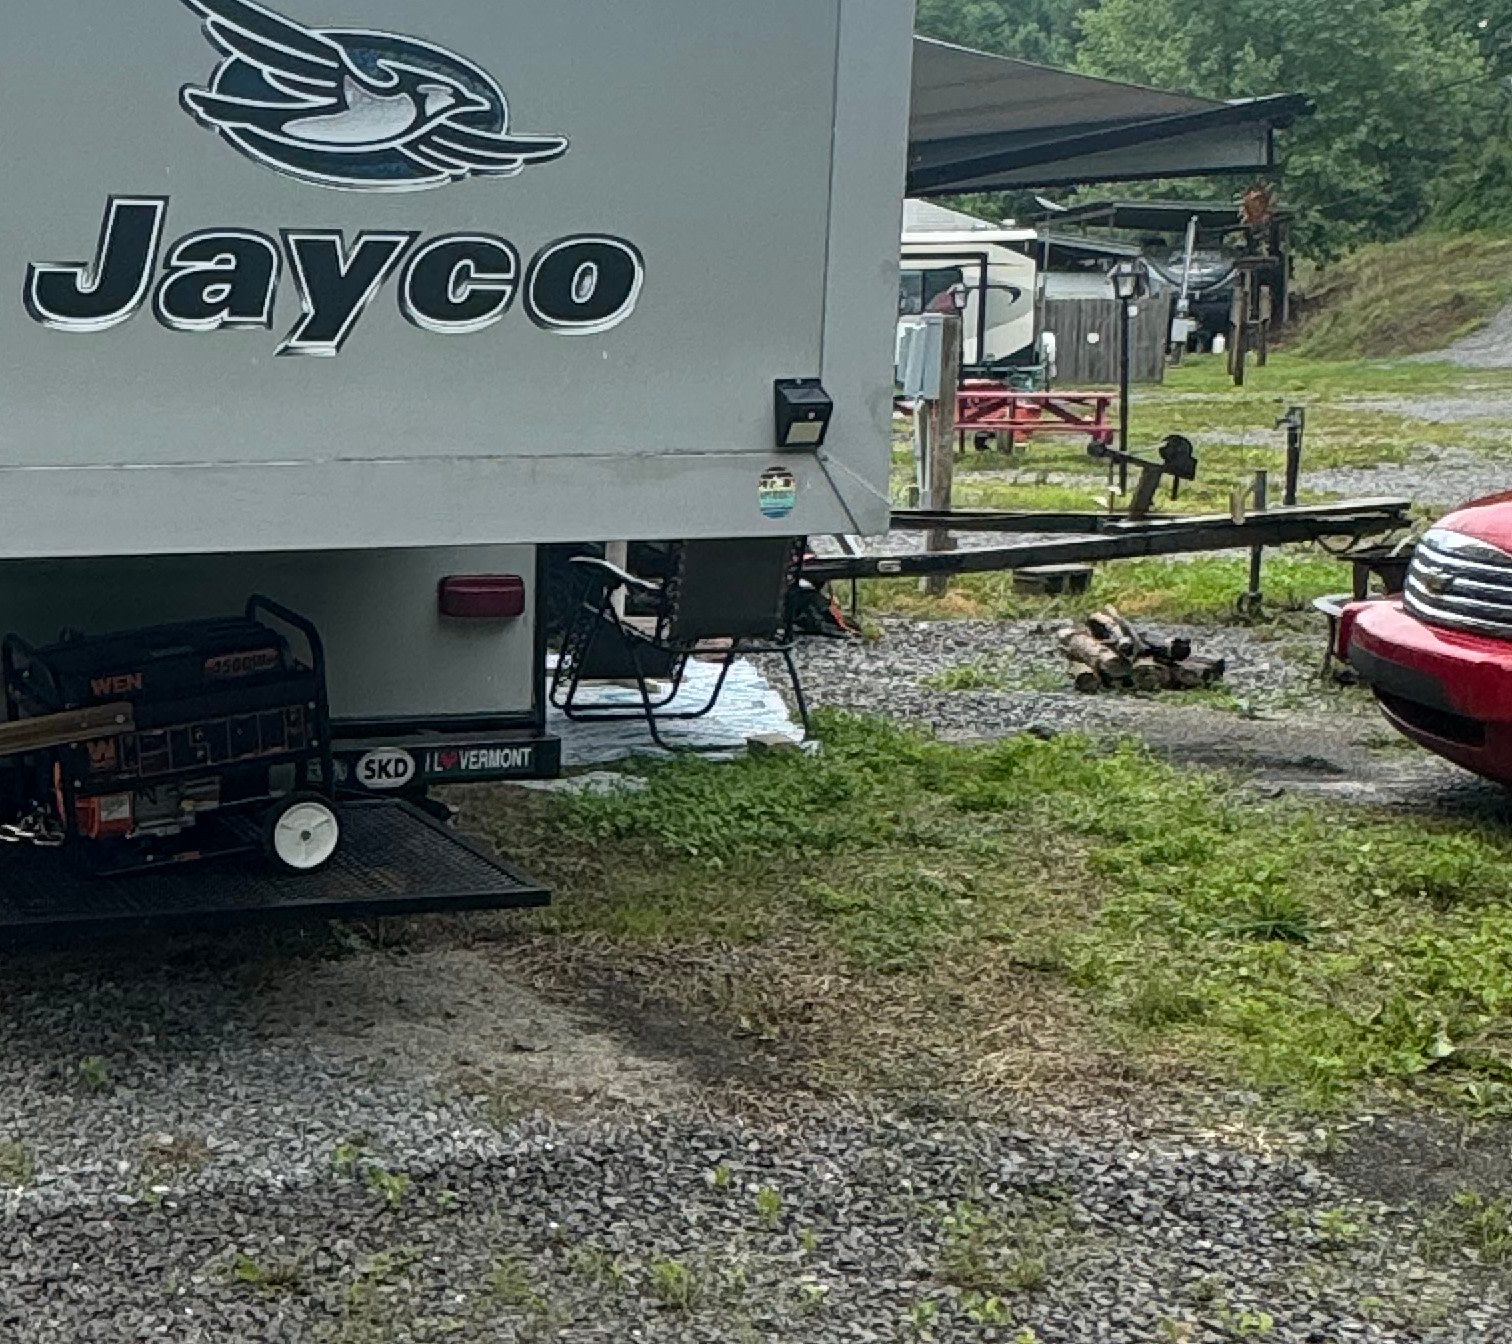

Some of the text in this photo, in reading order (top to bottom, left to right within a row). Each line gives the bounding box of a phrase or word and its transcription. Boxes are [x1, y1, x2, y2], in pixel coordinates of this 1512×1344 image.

[23, 194, 646, 357] Jayco
[90, 671, 146, 697] WEN
[363, 758, 409, 781] SKD
